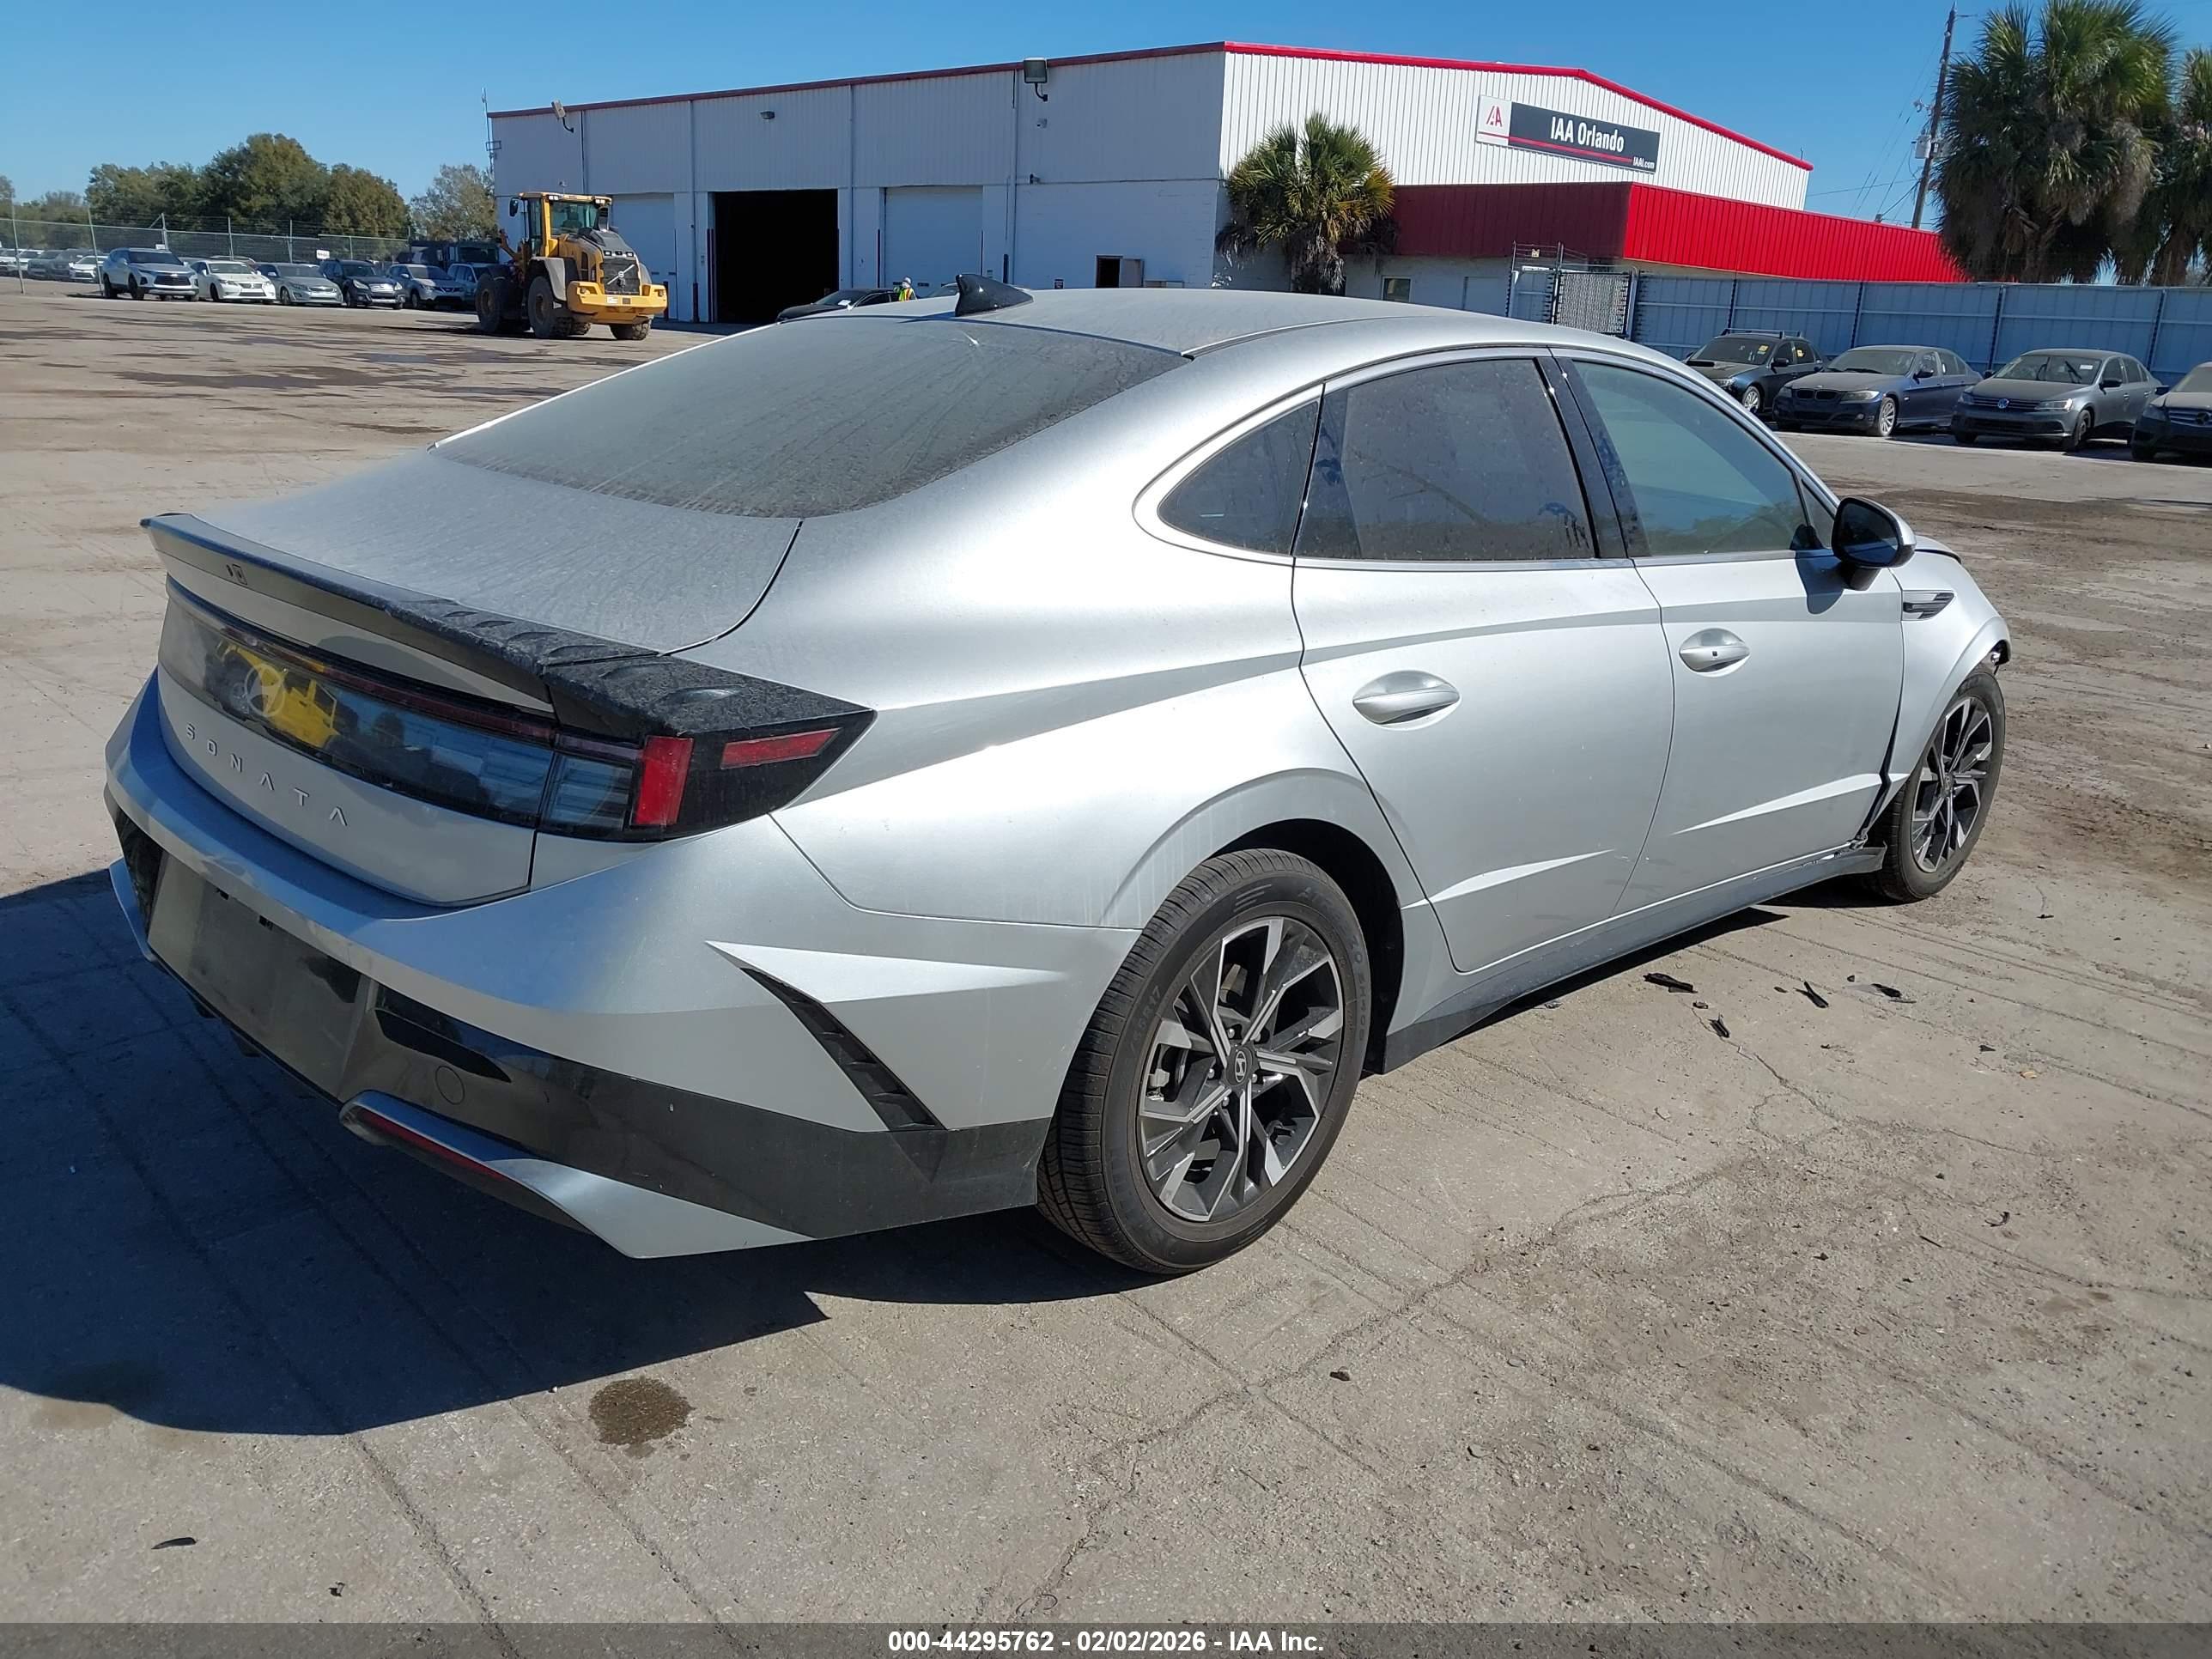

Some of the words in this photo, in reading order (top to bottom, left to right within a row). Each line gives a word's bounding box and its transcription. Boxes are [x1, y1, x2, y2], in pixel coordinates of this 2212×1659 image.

[1550, 116, 1574, 143] IAA
[1577, 122, 1625, 153] Orlando
[1632, 155, 1656, 169] IAAI.com
[185, 723, 349, 827] SONATA
